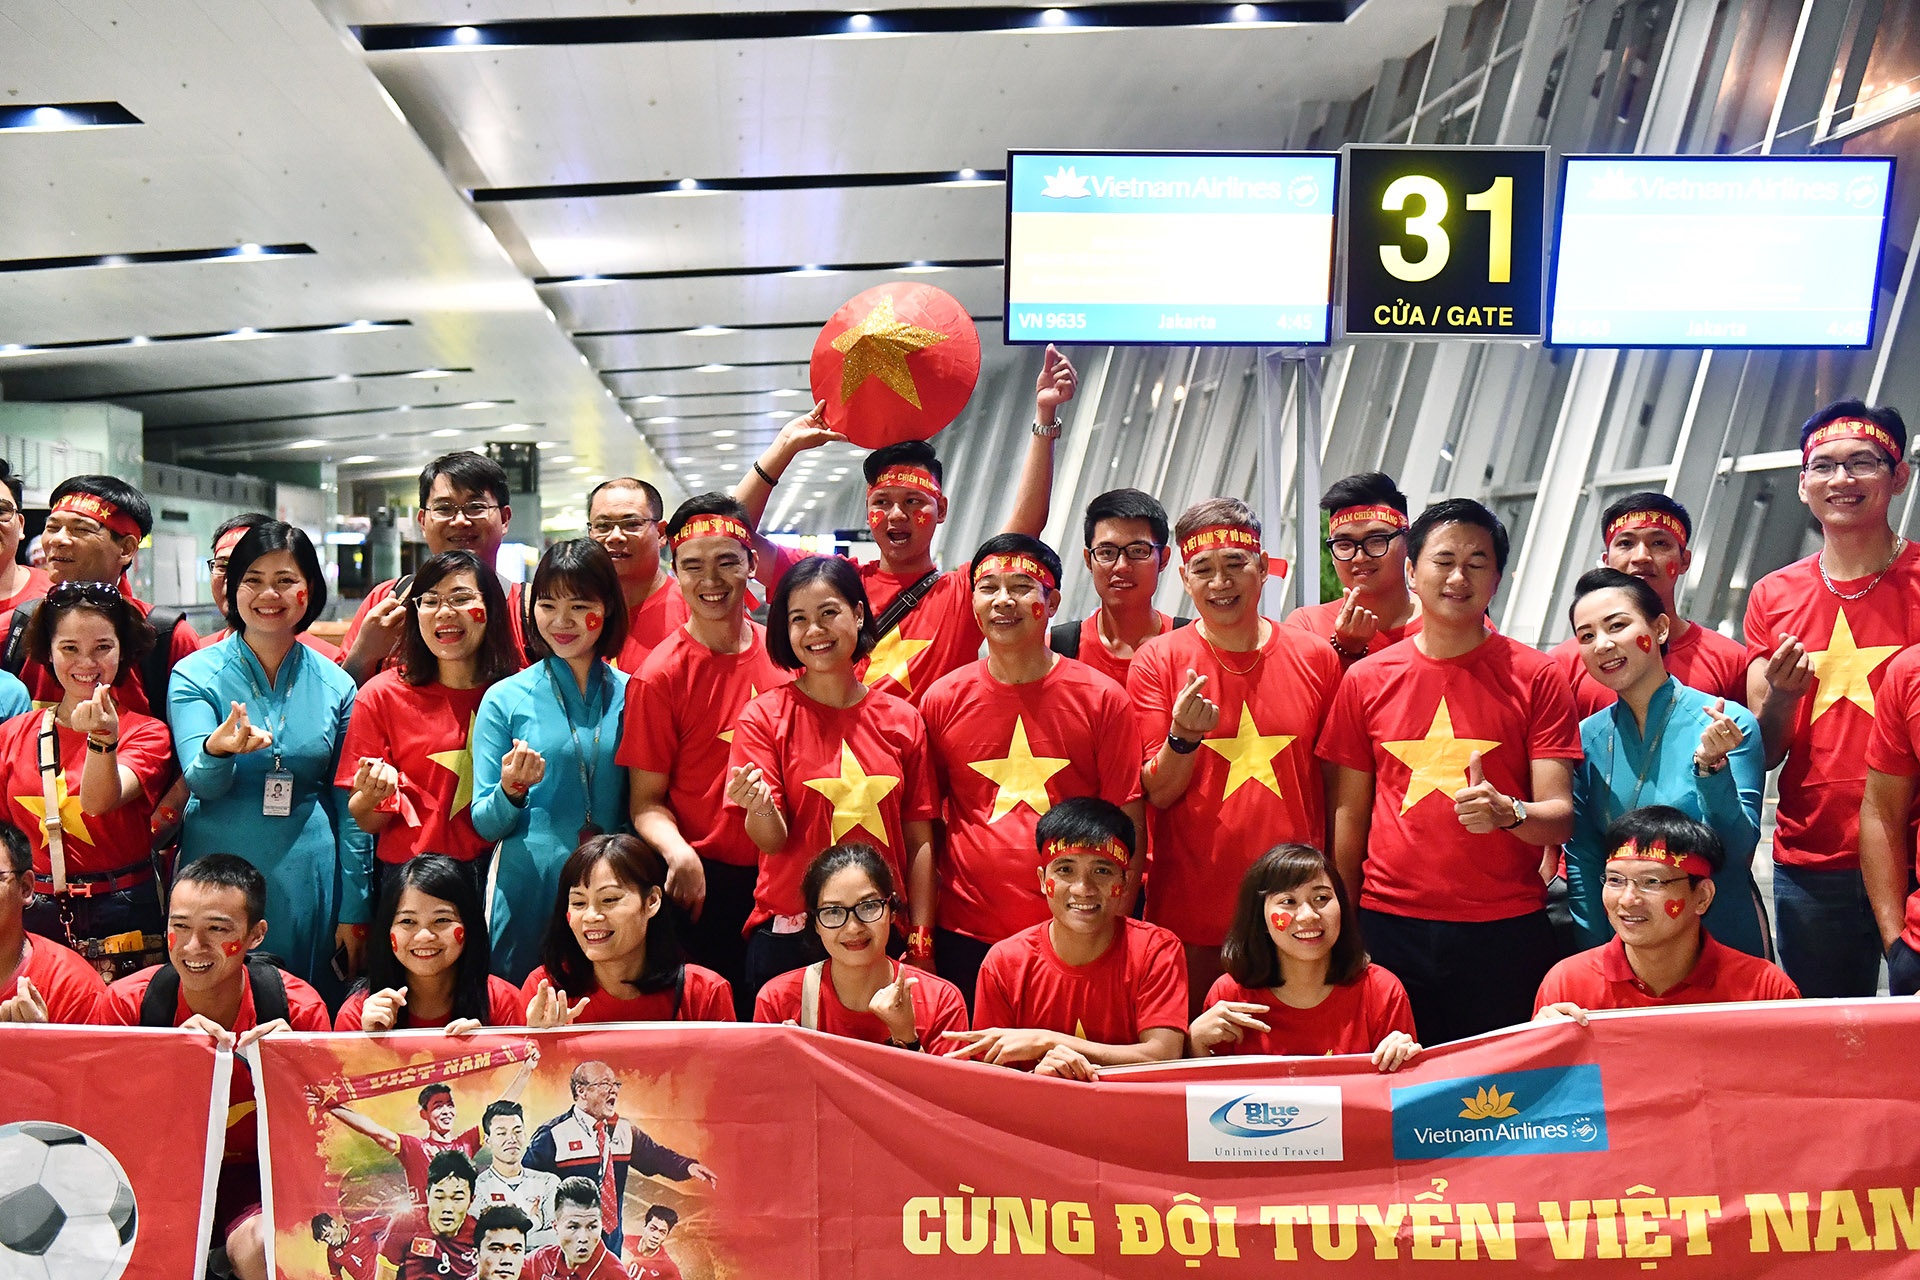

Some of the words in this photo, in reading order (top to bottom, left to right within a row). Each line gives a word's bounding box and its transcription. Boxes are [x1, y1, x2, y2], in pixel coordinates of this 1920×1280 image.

[1090, 175, 1191, 199] Vietnam
[1192, 175, 1282, 200] Airlines
[1379, 174, 1514, 283] 31
[1018, 312, 1043, 329] VN
[1045, 312, 1087, 329] 9635
[1373, 298, 1426, 326] CỬA
[1446, 306, 1514, 326] GATE
[1158, 312, 1216, 330] Jakarta
[1277, 312, 1313, 330] 4:45
[1827, 422, 1847, 435] NAM
[1339, 512, 1353, 525] NAM
[1354, 507, 1376, 521] CHIẾN
[1629, 511, 1646, 521] NAM
[692, 520, 710, 533] NAM
[1197, 531, 1214, 546] NAM
[1243, 1102, 1300, 1117] Blue
[1246, 1113, 1294, 1128] Sky
[1413, 1127, 1494, 1144] Vietnam
[1495, 1122, 1568, 1141] Airlines
[1214, 1146, 1278, 1157] Unlimited
[1282, 1146, 1325, 1156] Travel
[902, 1183, 1095, 1255] CÙNG
[1115, 1192, 1241, 1268] ĐỘI
[1259, 1178, 1517, 1261] TUYỂN
[1538, 1183, 1723, 1270] VIỆT
[1744, 1187, 1920, 1252] NAM
